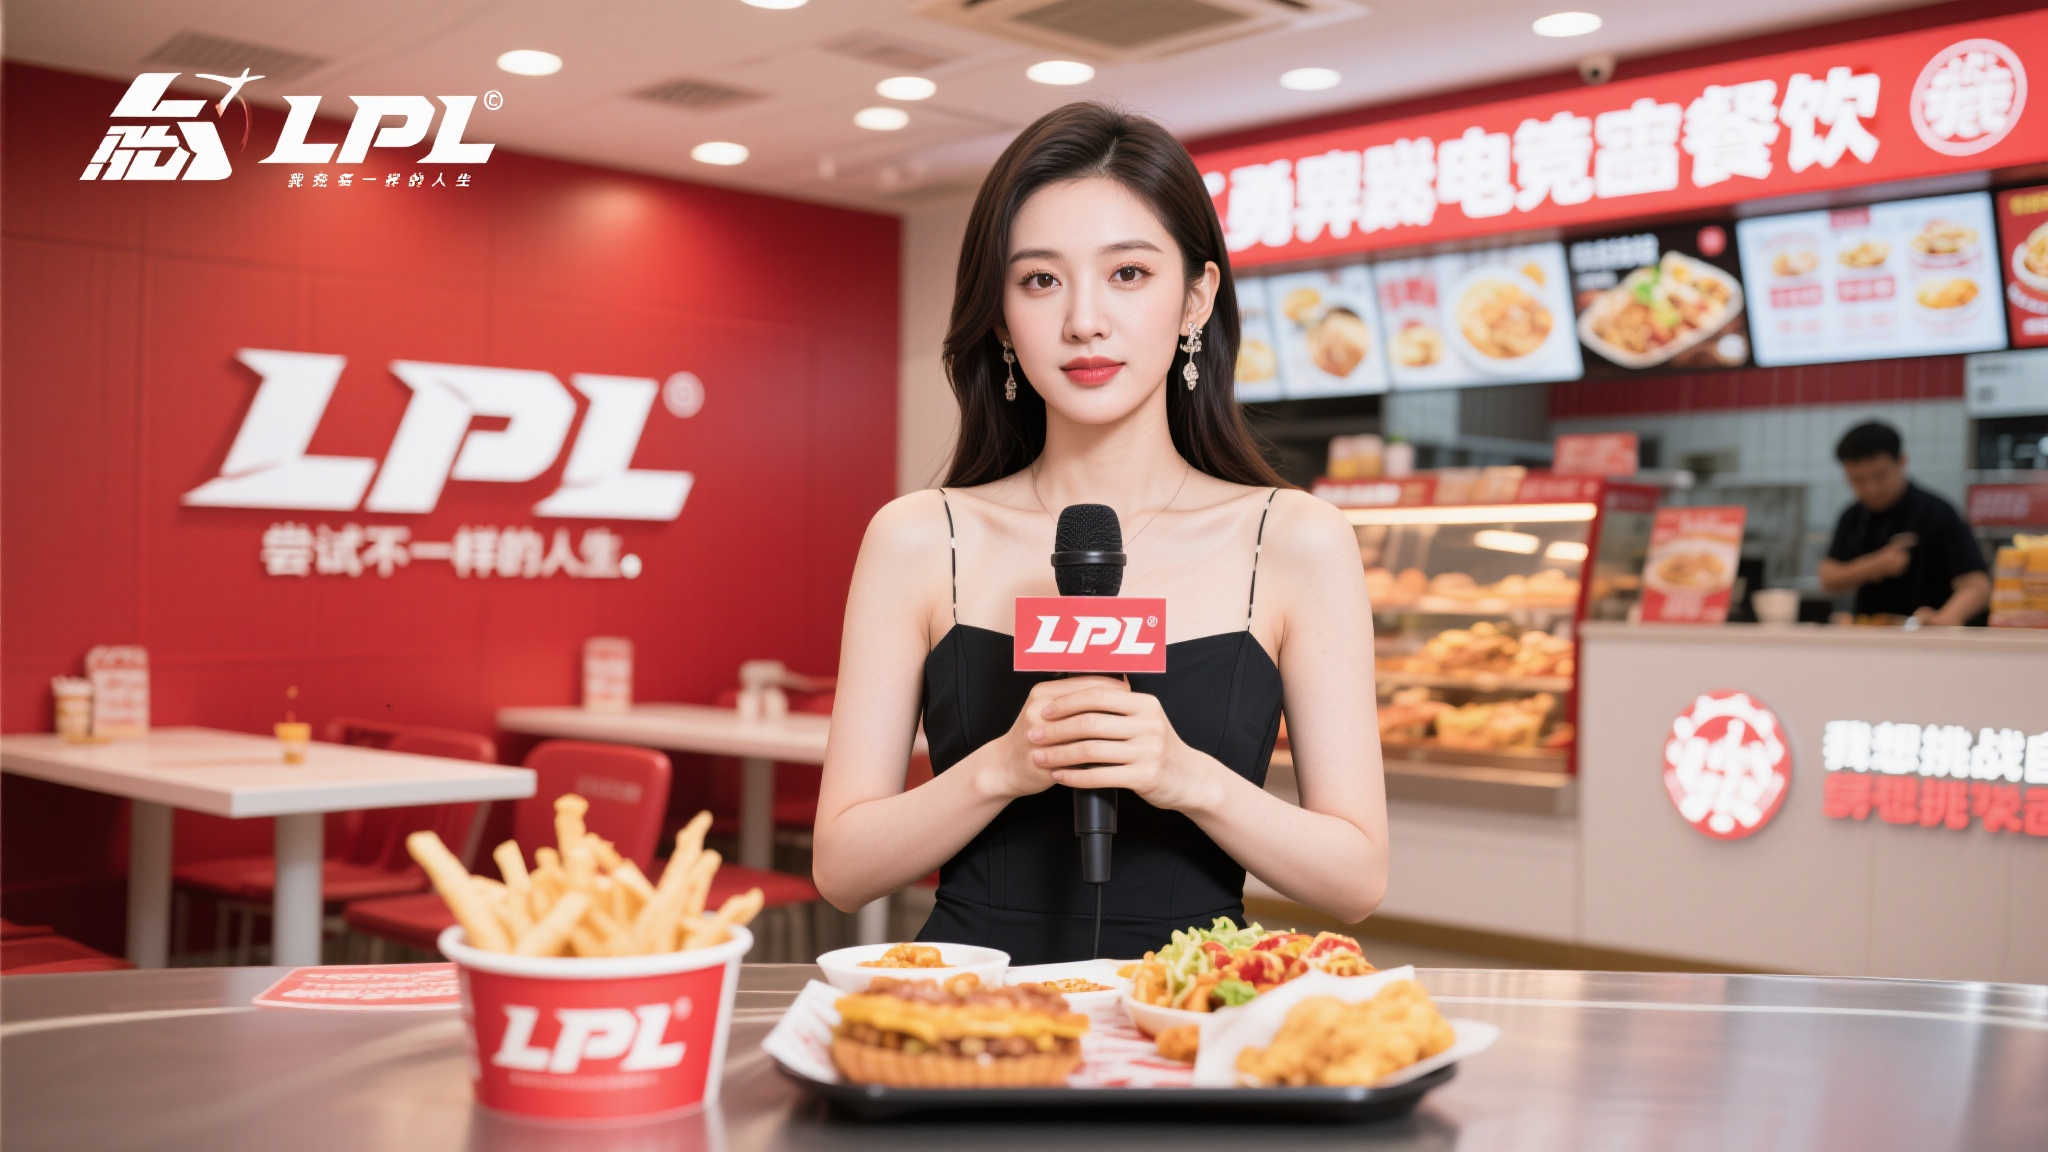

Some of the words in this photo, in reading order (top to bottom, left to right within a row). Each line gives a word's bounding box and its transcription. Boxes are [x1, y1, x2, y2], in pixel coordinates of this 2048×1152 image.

[180, 347, 695, 521] LPL
[1024, 615, 1156, 655] LPL
[491, 1002, 687, 1074] LPL
